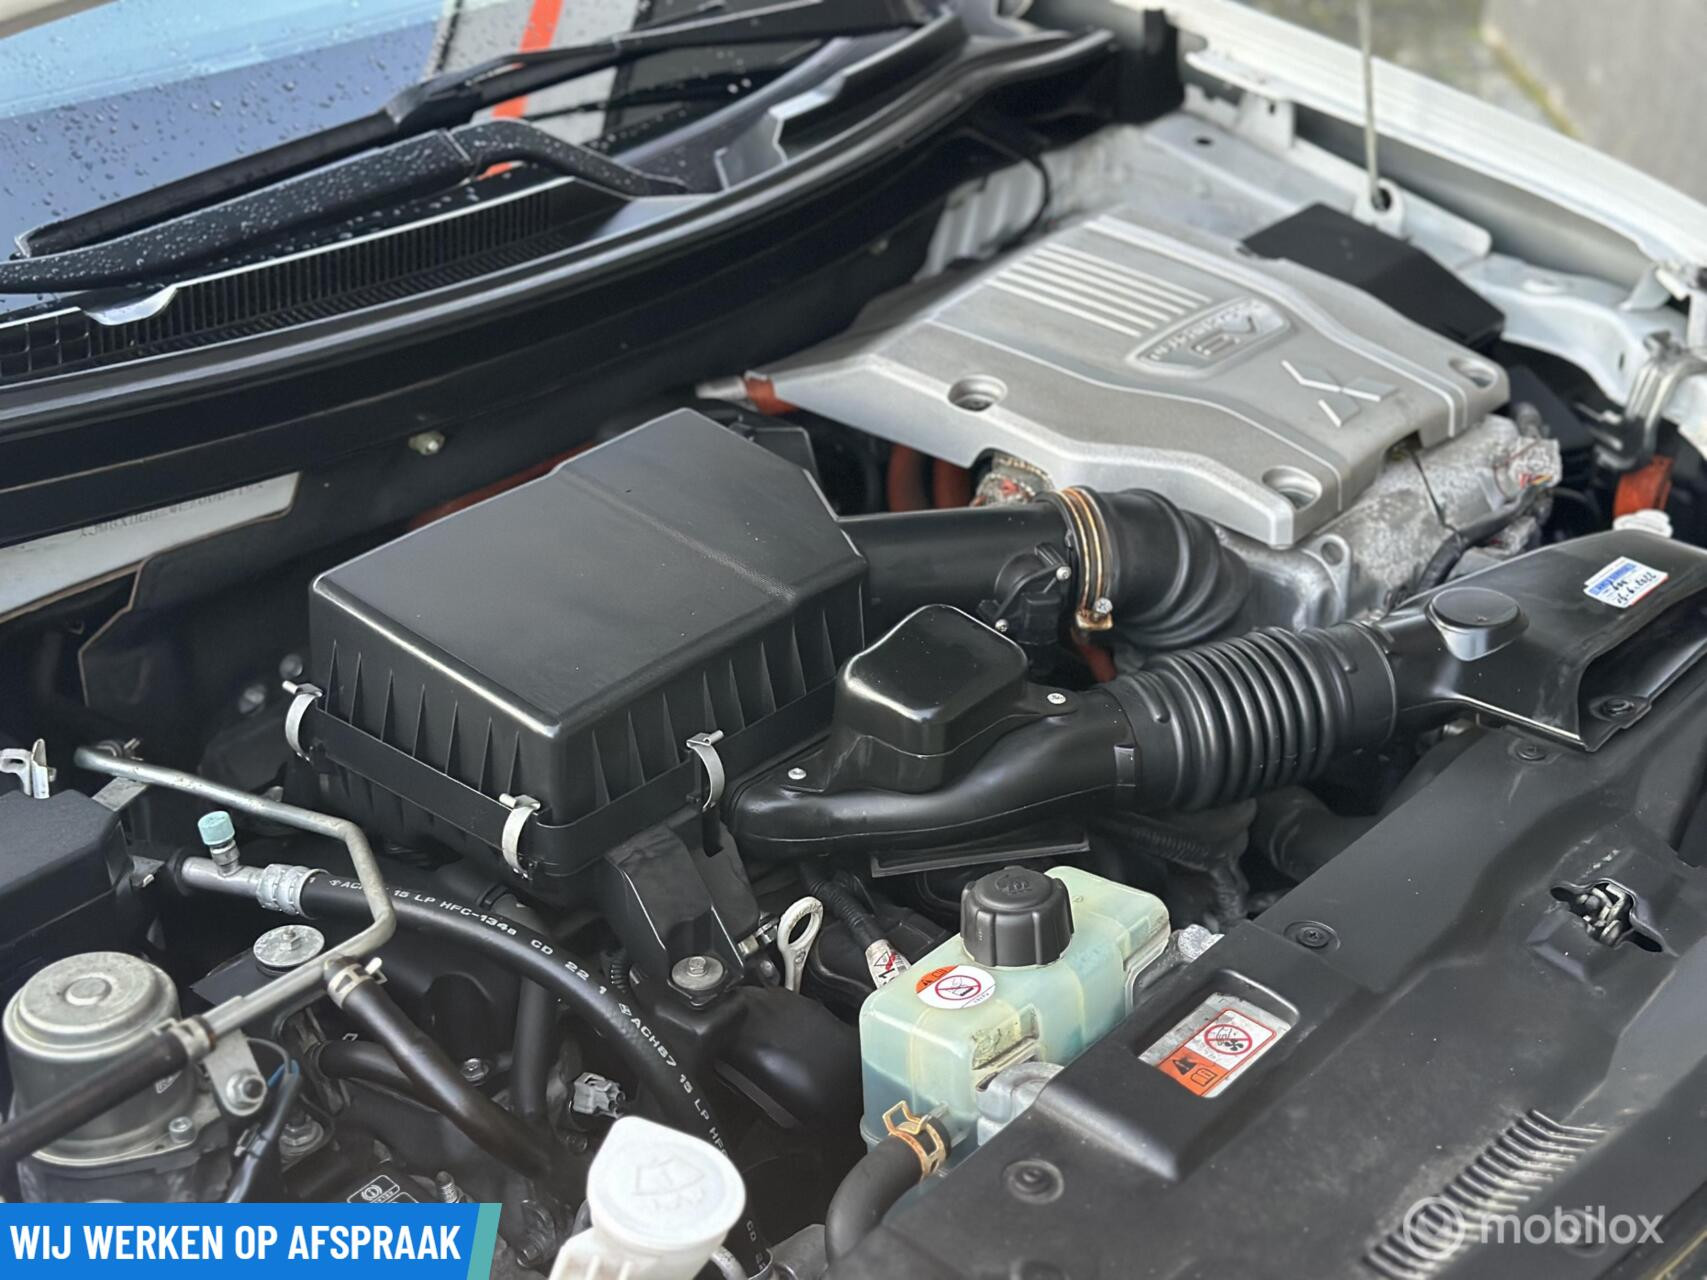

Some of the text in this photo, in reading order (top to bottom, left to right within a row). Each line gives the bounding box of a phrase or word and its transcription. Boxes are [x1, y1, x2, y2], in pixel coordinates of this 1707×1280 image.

[414, 894, 437, 903] LP
[439, 901, 517, 936] HFC-134a
[530, 939, 554, 955] CD
[564, 961, 591, 981] 22
[694, 1098, 711, 1121] LP
